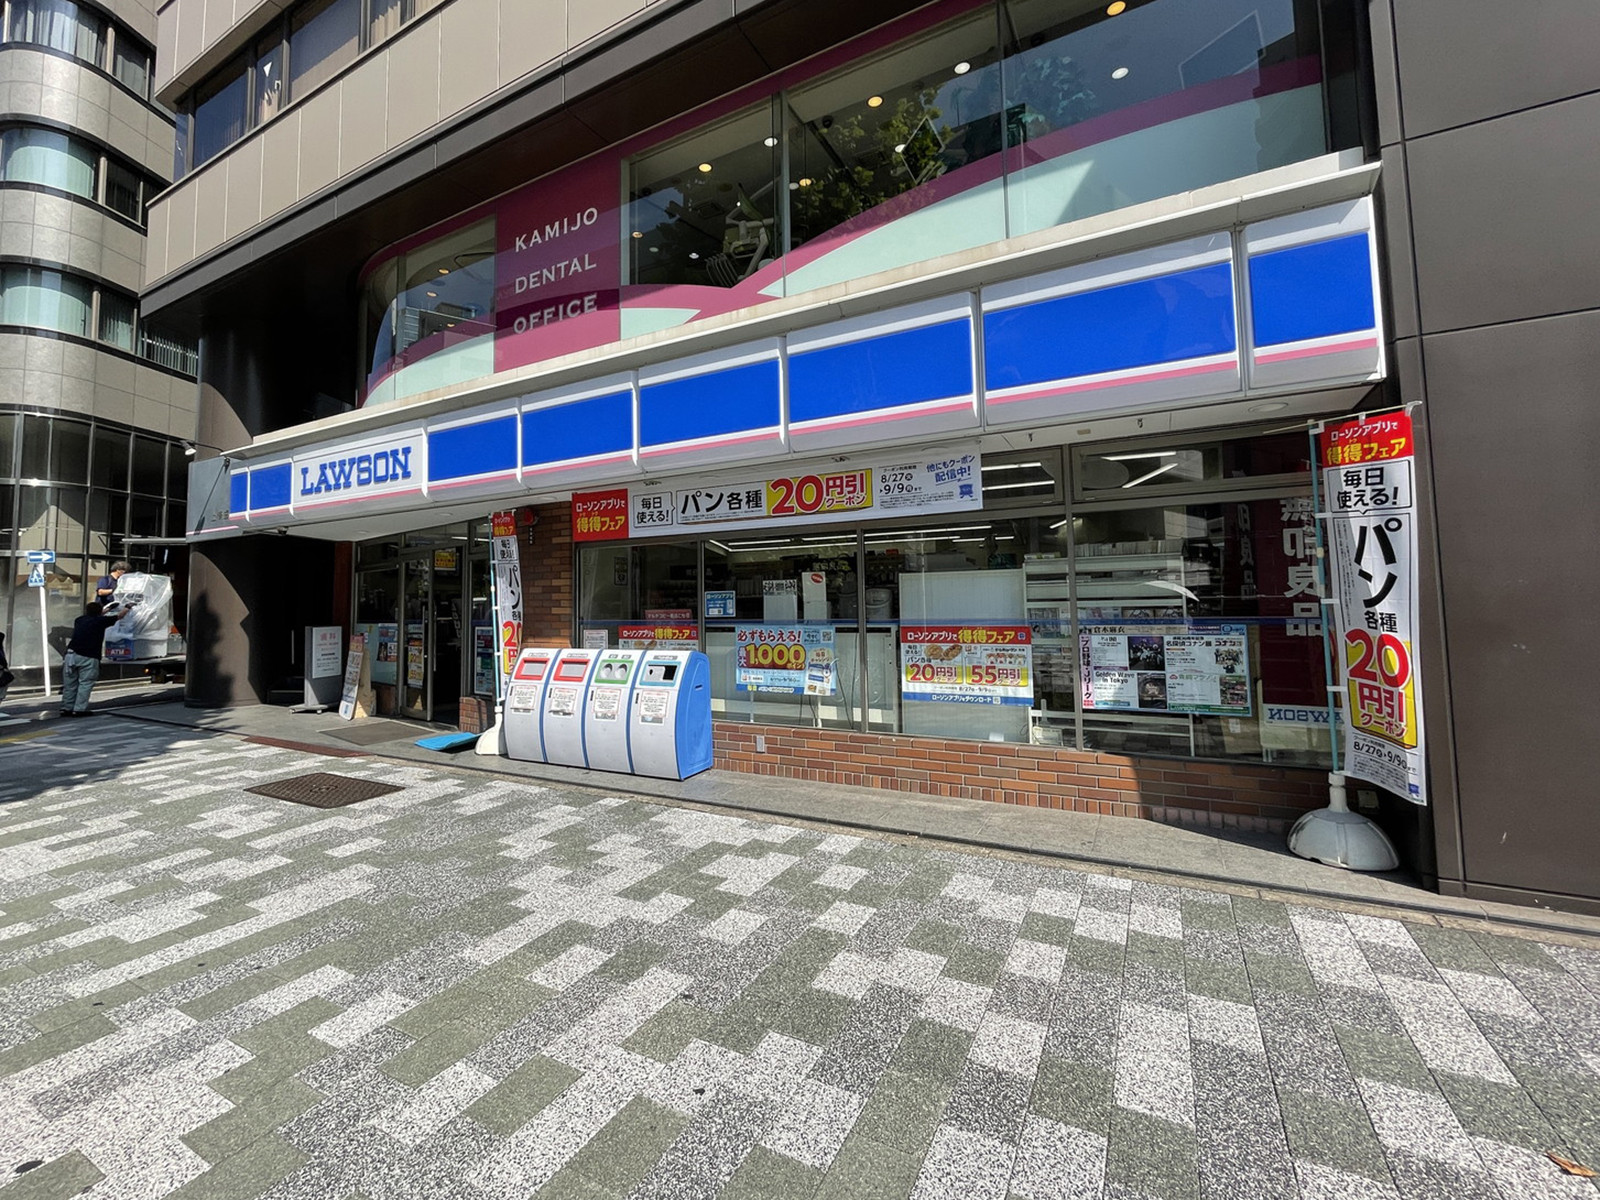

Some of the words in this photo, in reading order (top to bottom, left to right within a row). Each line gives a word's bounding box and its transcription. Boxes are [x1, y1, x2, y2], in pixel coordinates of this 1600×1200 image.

[515, 207, 598, 253] KAMIJO
[515, 253, 597, 294] DENTAL
[513, 294, 598, 335] OFFICE
[1331, 420, 1399, 441] ローソンアプリで
[1326, 437, 1406, 465] 得得フェア
[300, 446, 412, 496] LAWSON
[926, 454, 976, 473] 他にもクーポン
[1343, 467, 1385, 488] 毎日
[576, 497, 625, 512] ローソンアプリで
[641, 496, 662, 510] 毎日
[681, 490, 763, 515] パン各種
[825, 494, 866, 508] クーポン
[1337, 487, 1399, 508] 使える!
[576, 515, 625, 533] 得得フェア
[636, 510, 669, 524] 使える!
[1354, 517, 1402, 609] パン
[508, 564, 521, 610] パン
[1364, 610, 1398, 633] 各種
[737, 628, 802, 643] 必ずもらえる!
[907, 631, 957, 641] ローソンアプリで
[958, 629, 1015, 643] 得得フェア
[1344, 628, 1411, 688] 20
[1358, 681, 1405, 723] 円引
[1360, 712, 1407, 738] クーポン
